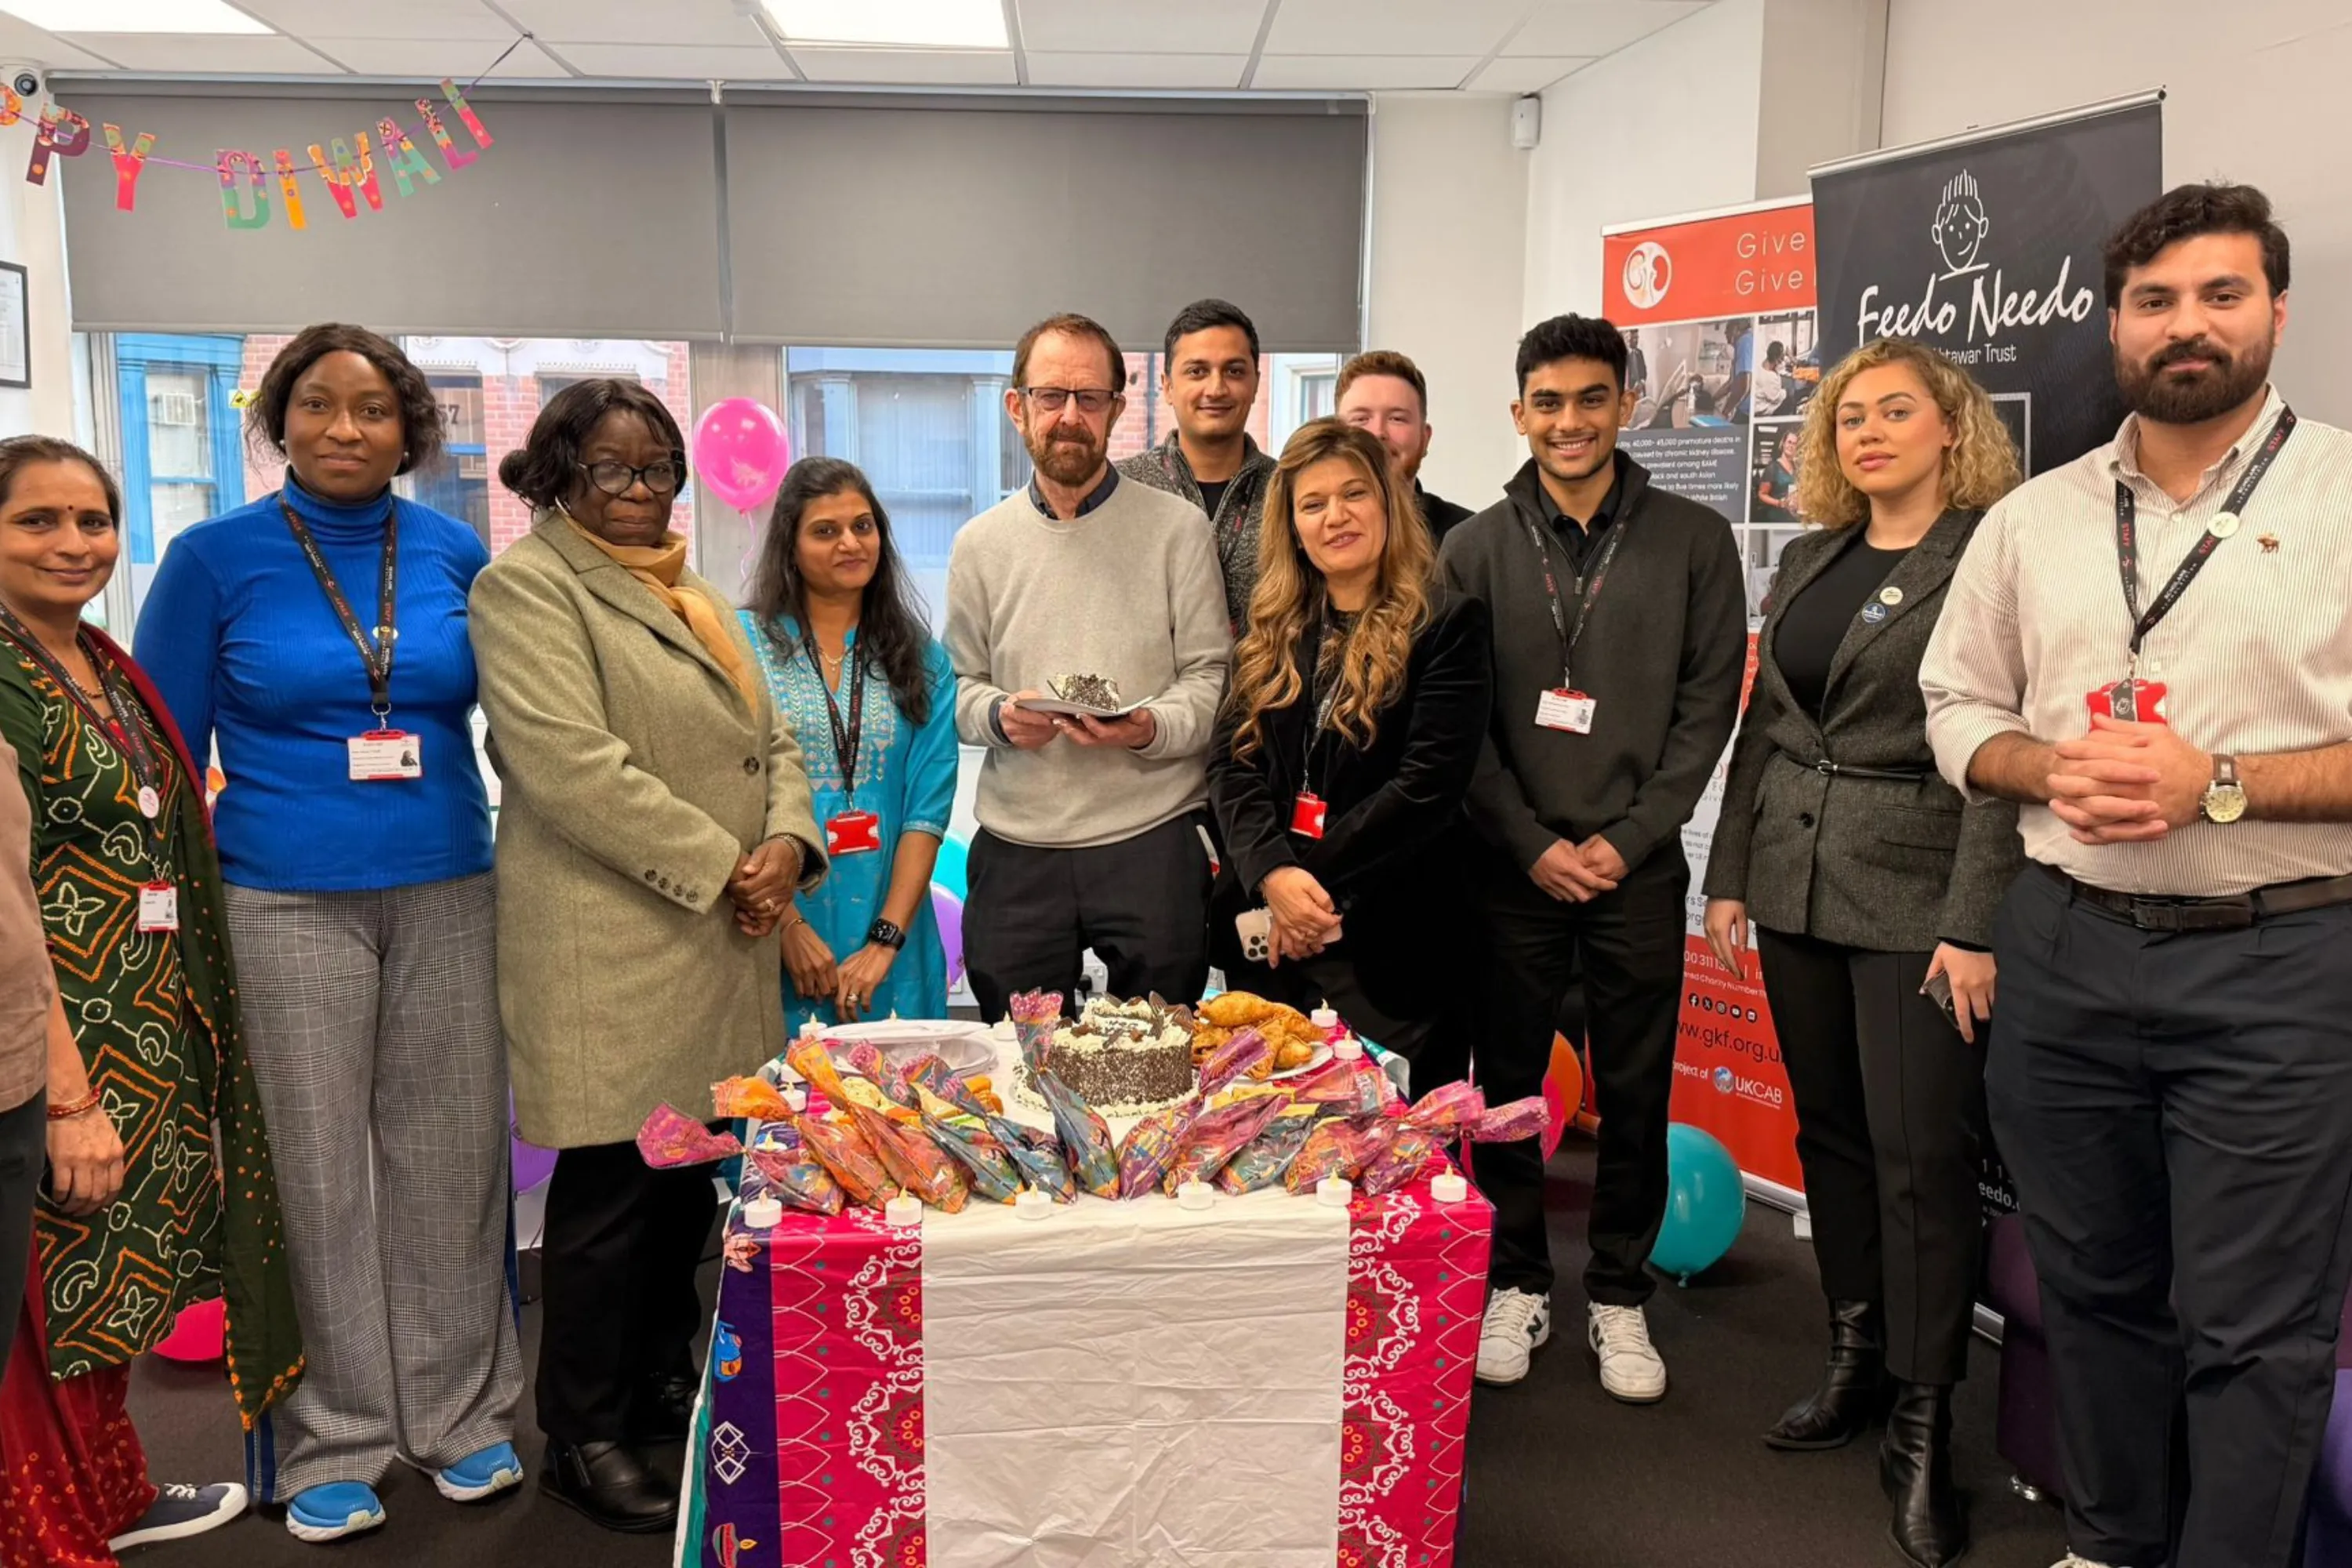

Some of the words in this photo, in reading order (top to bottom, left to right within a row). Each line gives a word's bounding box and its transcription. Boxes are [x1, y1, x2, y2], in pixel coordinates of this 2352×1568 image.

[215, 78, 495, 229] DIWALI
[1737, 230, 1806, 259] Give
[1735, 267, 1803, 296] Give
[1857, 272, 1957, 348] Feedo
[1968, 255, 2094, 343] Needo
[1984, 343, 2017, 363] Trust
[1700, 973, 1726, 989] Charity
[1726, 981, 1758, 995] Number
[1677, 1020, 1780, 1064] w.gkf.org.u
[1735, 1076, 1783, 1104] UKCAB
